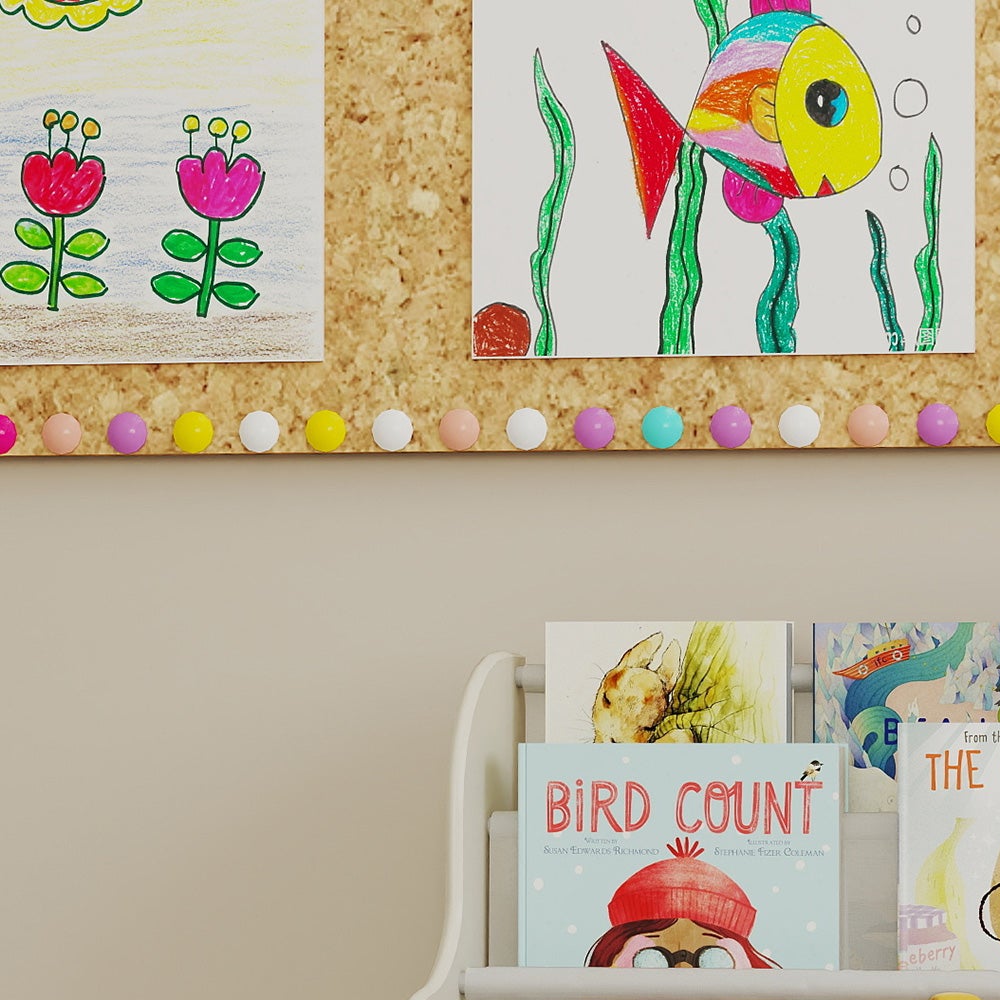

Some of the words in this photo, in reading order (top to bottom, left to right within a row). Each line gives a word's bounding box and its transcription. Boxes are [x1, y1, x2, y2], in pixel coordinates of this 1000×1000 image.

[964, 731, 988, 743] From
[925, 749, 984, 791] THE
[676, 781, 823, 834] COUNT
